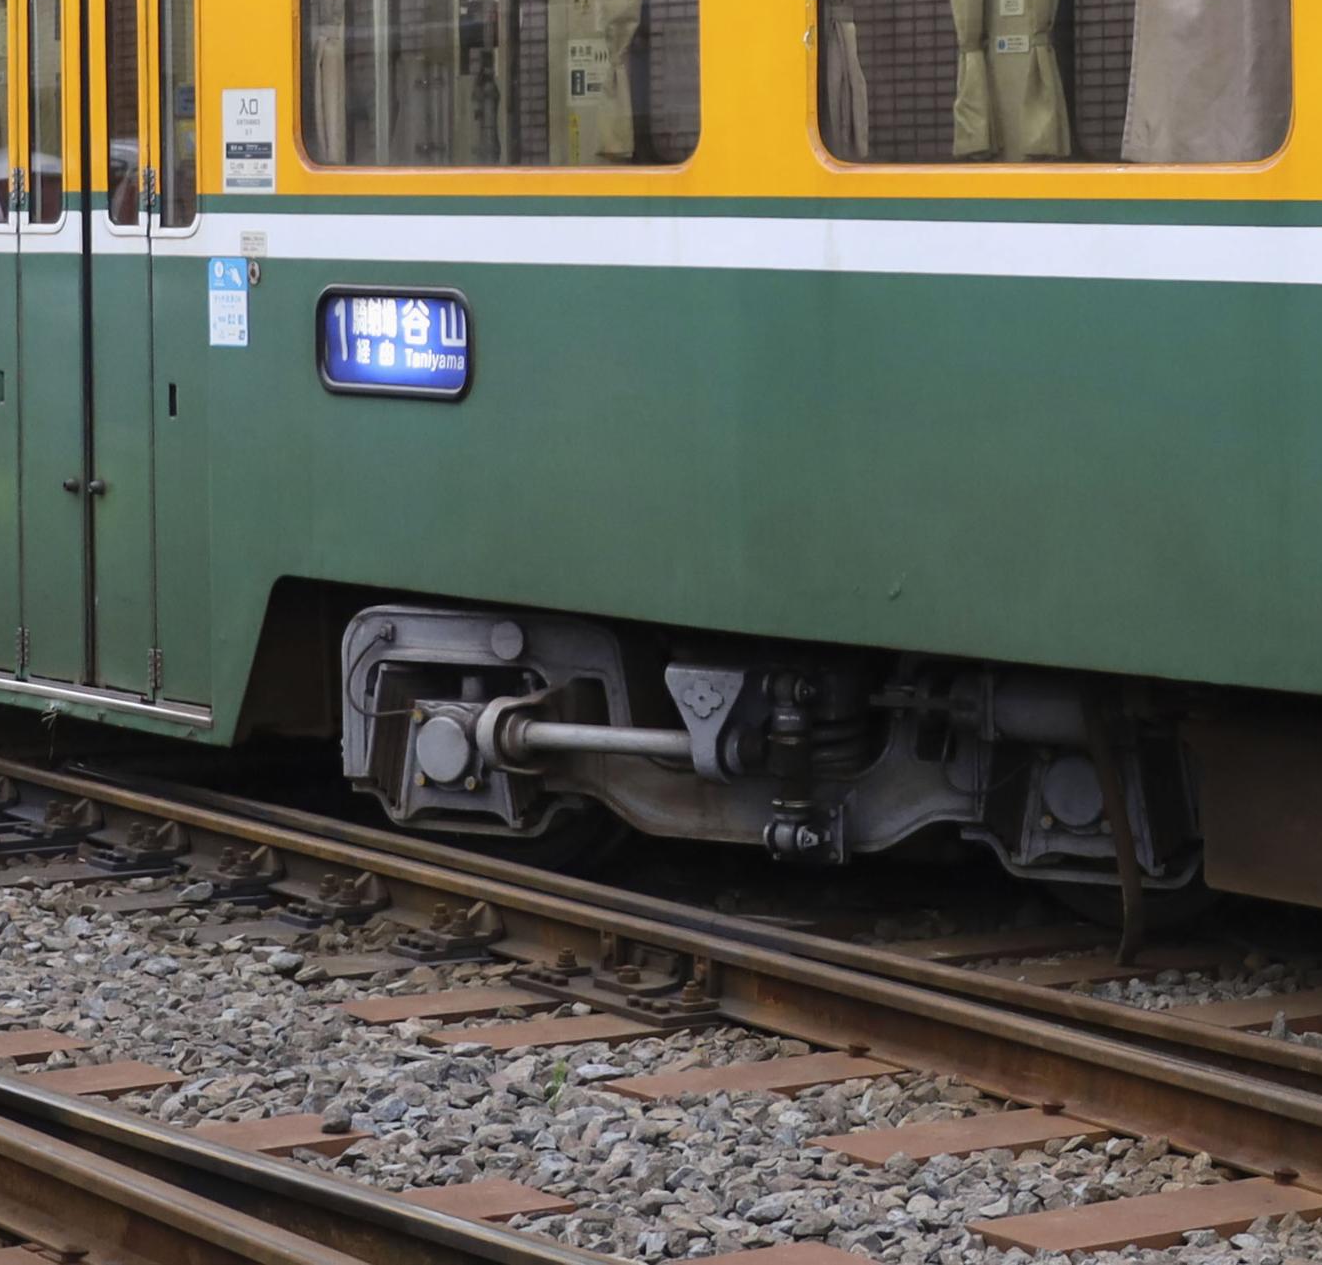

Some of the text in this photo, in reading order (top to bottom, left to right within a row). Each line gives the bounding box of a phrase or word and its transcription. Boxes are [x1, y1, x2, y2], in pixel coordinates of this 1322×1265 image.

[239, 98, 259, 116] 入口
[334, 298, 349, 361] 1
[401, 299, 466, 347] 谷山
[404, 348, 465, 372] Taniyama
